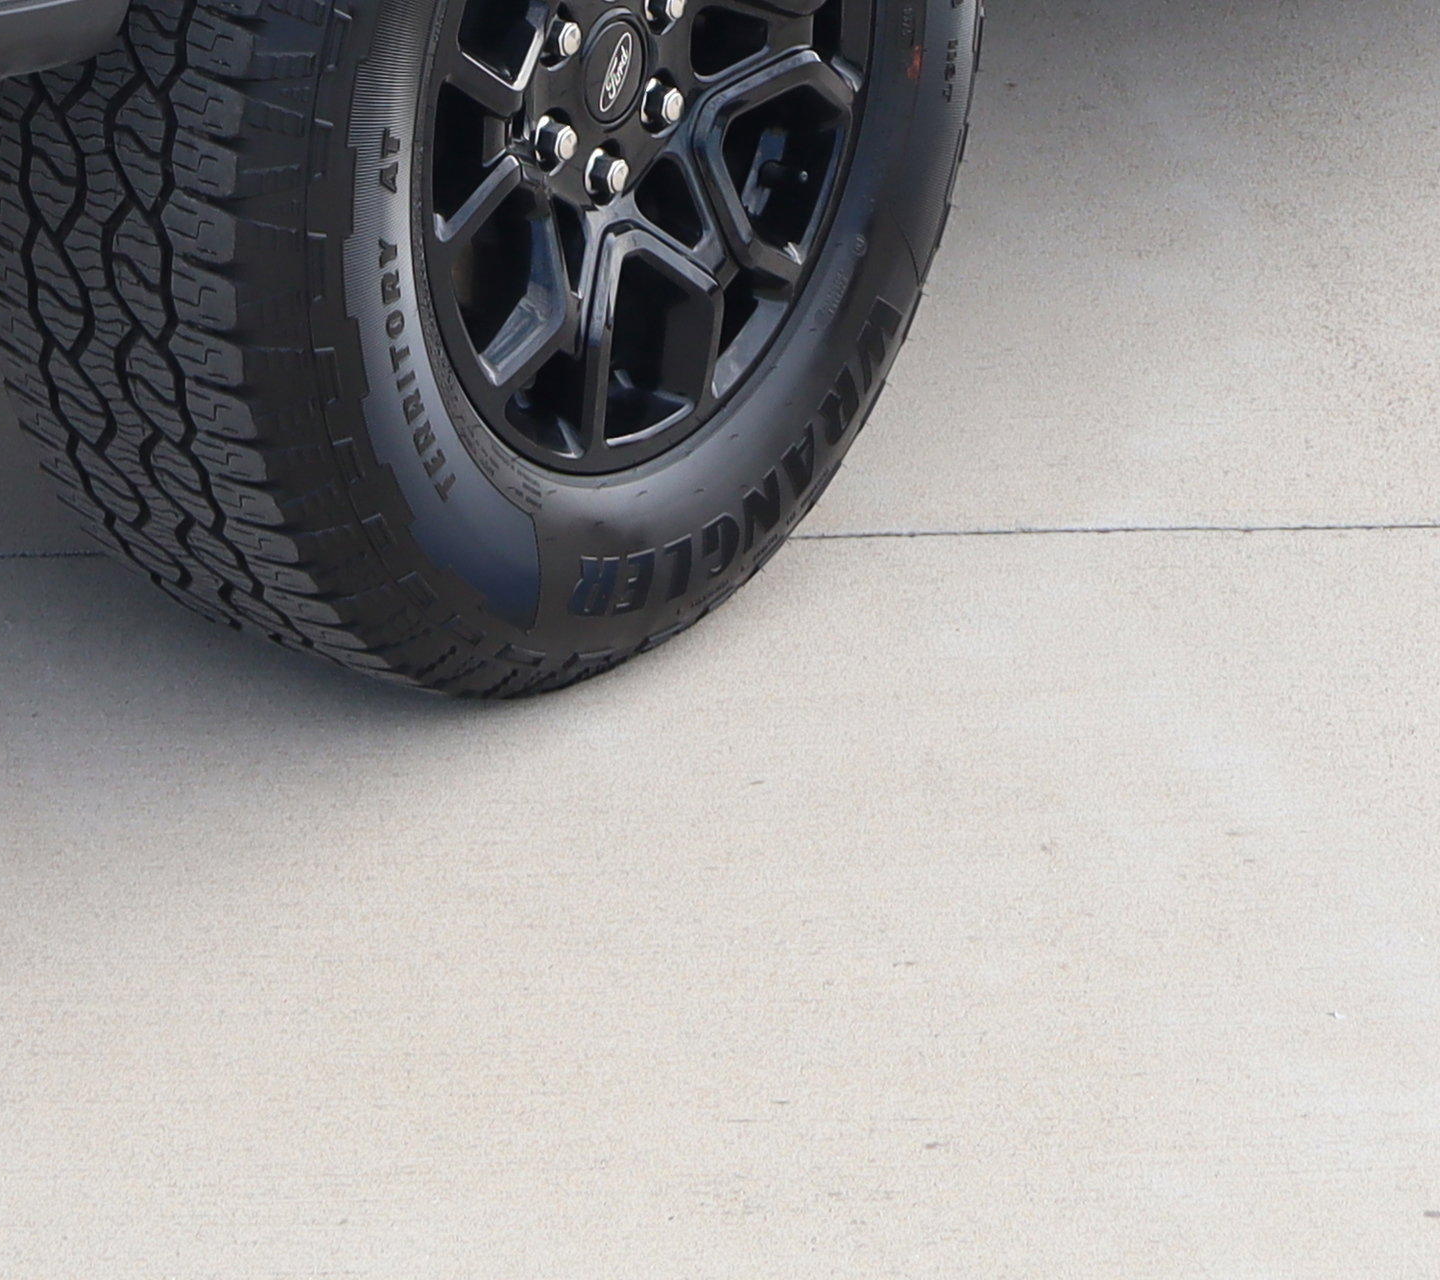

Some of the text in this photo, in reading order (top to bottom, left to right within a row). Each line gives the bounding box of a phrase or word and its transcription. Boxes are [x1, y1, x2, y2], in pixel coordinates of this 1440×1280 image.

[605, 44, 628, 100] Ford
[378, 127, 457, 504] TERRITORY AT
[570, 295, 904, 617] WRANGLER
